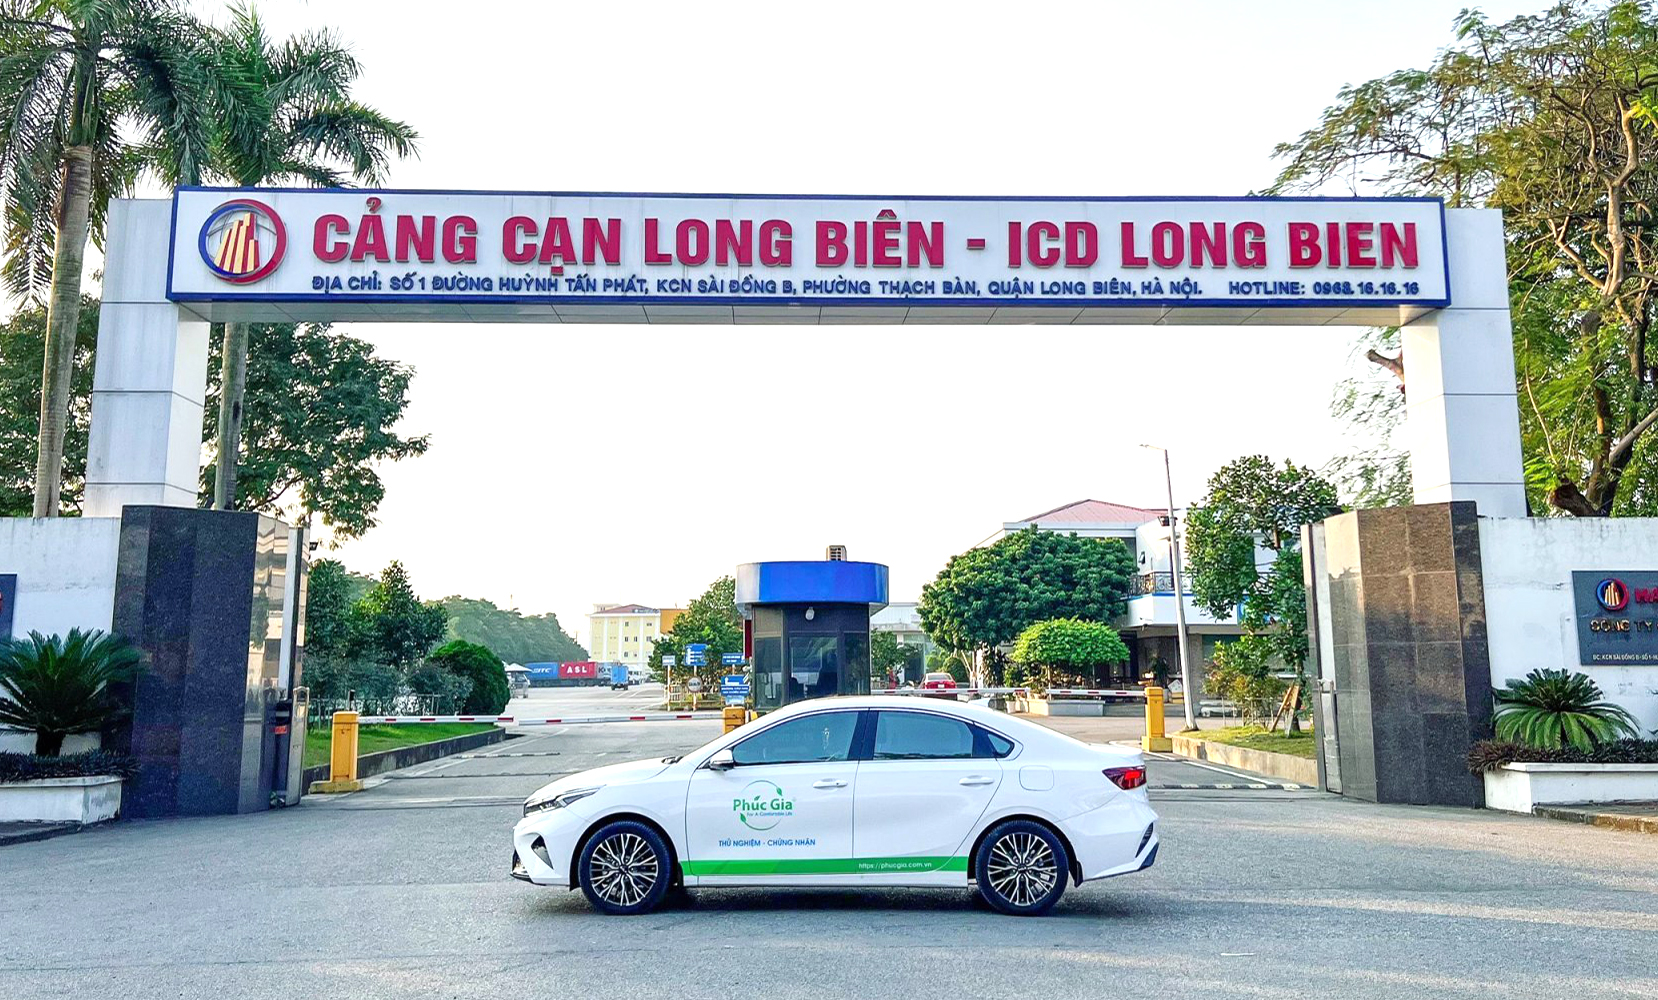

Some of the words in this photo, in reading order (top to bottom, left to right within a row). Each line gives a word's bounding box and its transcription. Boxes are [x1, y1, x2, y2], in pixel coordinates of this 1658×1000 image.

[313, 197, 478, 263] CẢNG
[503, 216, 622, 275] CẠN
[644, 217, 793, 266] LONG
[815, 209, 945, 267] BIÊN
[967, 238, 985, 249] -
[1008, 221, 1098, 268] ICD
[1121, 221, 1267, 268] LONG
[1287, 222, 1419, 268] BIEN
[312, 276, 343, 293] ĐỊA
[347, 270, 382, 291] CHỈ:
[389, 271, 417, 291] SỐ
[418, 276, 426, 291] 1
[432, 271, 493, 292] ĐƯỜNG
[499, 271, 558, 292] HUỲNH
[565, 273, 596, 292] TẤN
[602, 274, 649, 294] PHÁT,
[657, 279, 691, 293] KCN
[697, 274, 724, 294] SÀI
[728, 274, 776, 294] ĐỒNG
[783, 280, 797, 295] B,
[802, 274, 870, 295] PHƯỜNG
[878, 280, 935, 298] THẠCH
[942, 276, 981, 296] BÀN,
[987, 277, 1035, 298] QUẬN
[1040, 281, 1087, 295] LONG
[1092, 277, 1137, 297] BIÊN,
[1141, 277, 1165, 295] HÀ
[1169, 277, 1203, 298] NỘI.
[1228, 281, 1306, 295] HOTLINE:
[566, 665, 587, 674] ASL
[733, 795, 766, 811] Phúc
[770, 798, 793, 811] Gia
[732, 838, 761, 847] NGHIỆM
